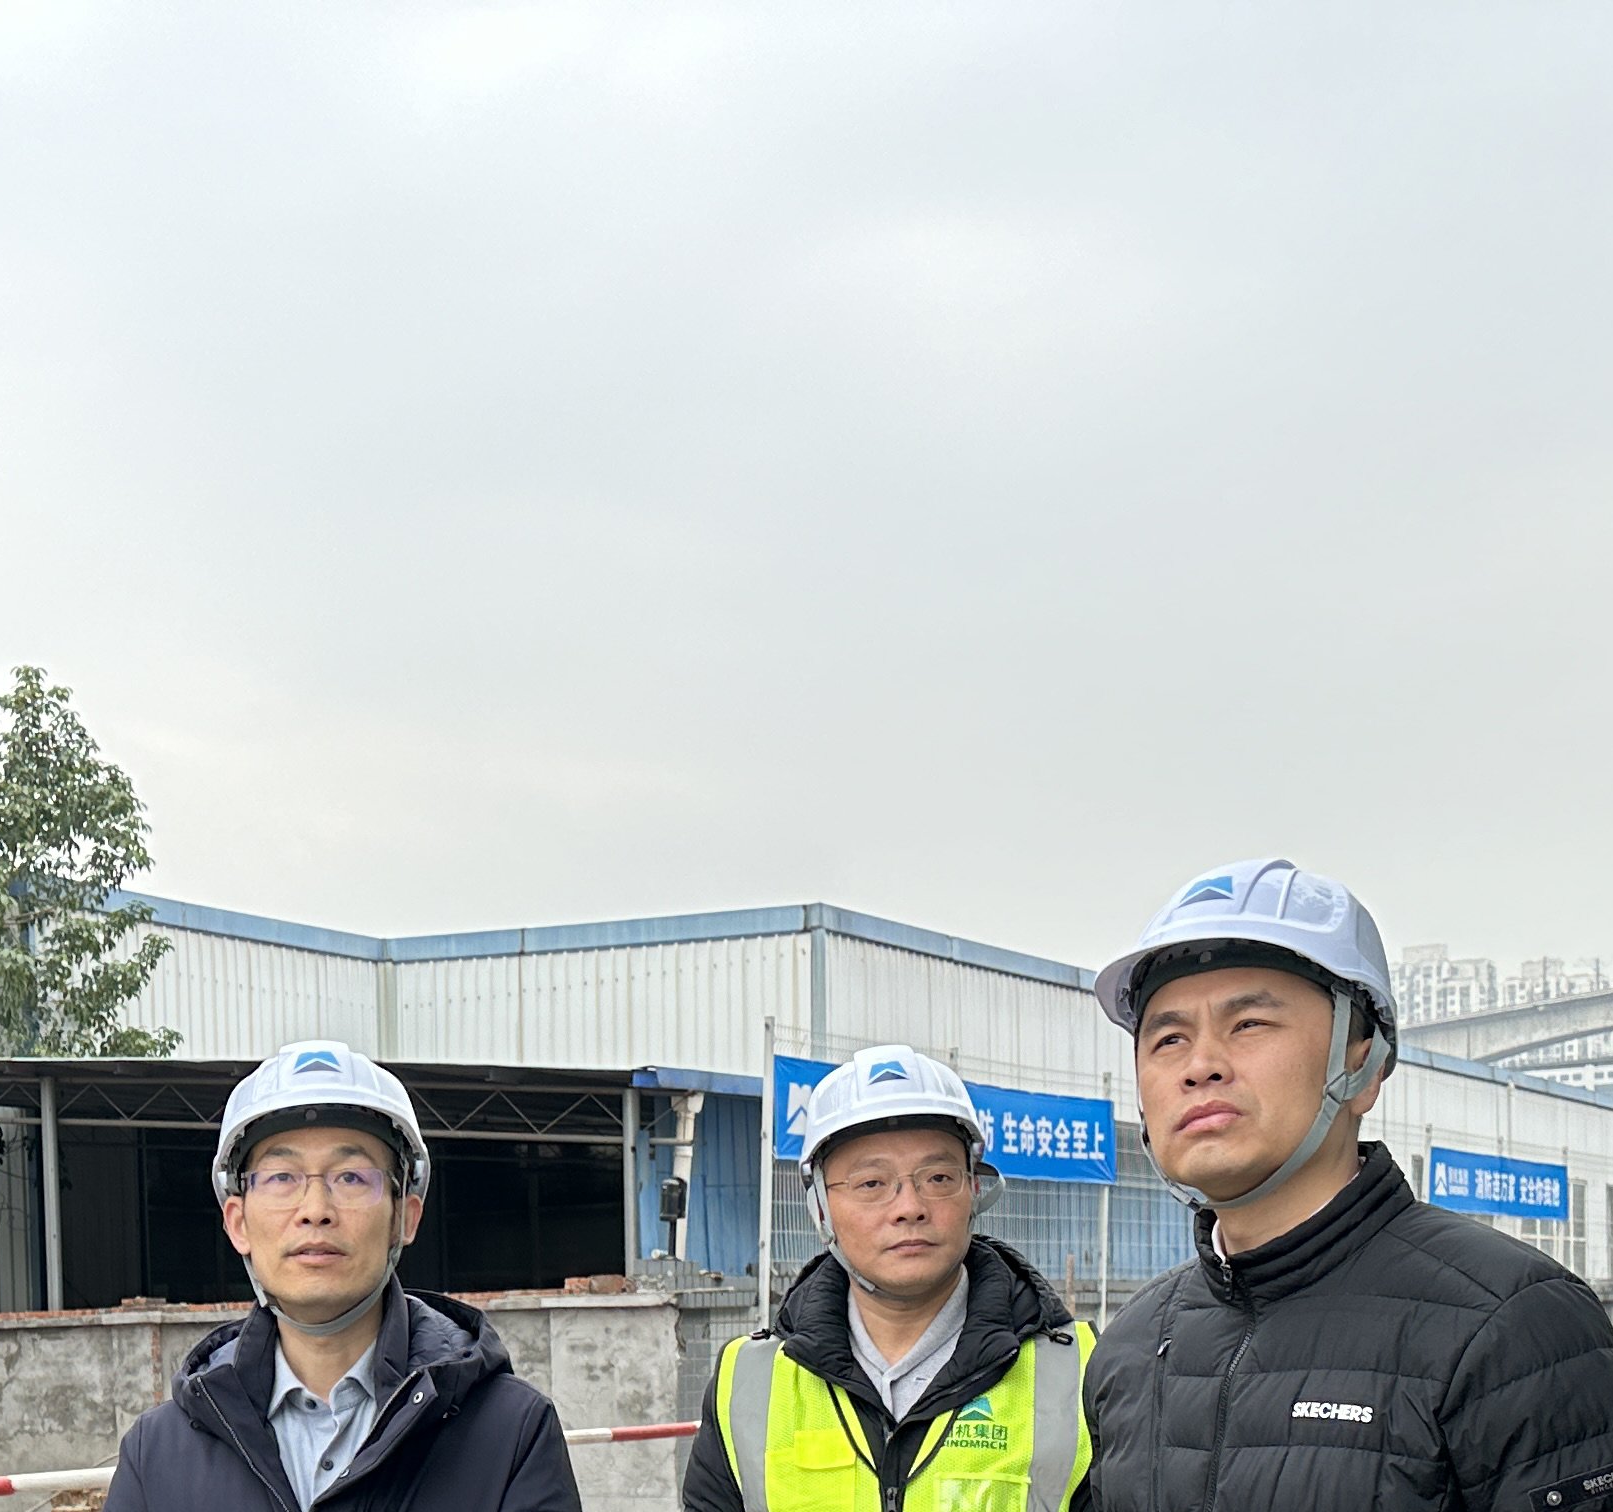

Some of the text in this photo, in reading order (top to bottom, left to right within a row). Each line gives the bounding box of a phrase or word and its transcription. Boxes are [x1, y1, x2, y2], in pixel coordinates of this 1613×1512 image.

[1002, 1112, 1105, 1161] 生命安全至上
[1292, 1402, 1373, 1423] SKECHERS
[950, 1424, 1008, 1441] 机集团
[945, 1440, 1007, 1450] INOMACH
